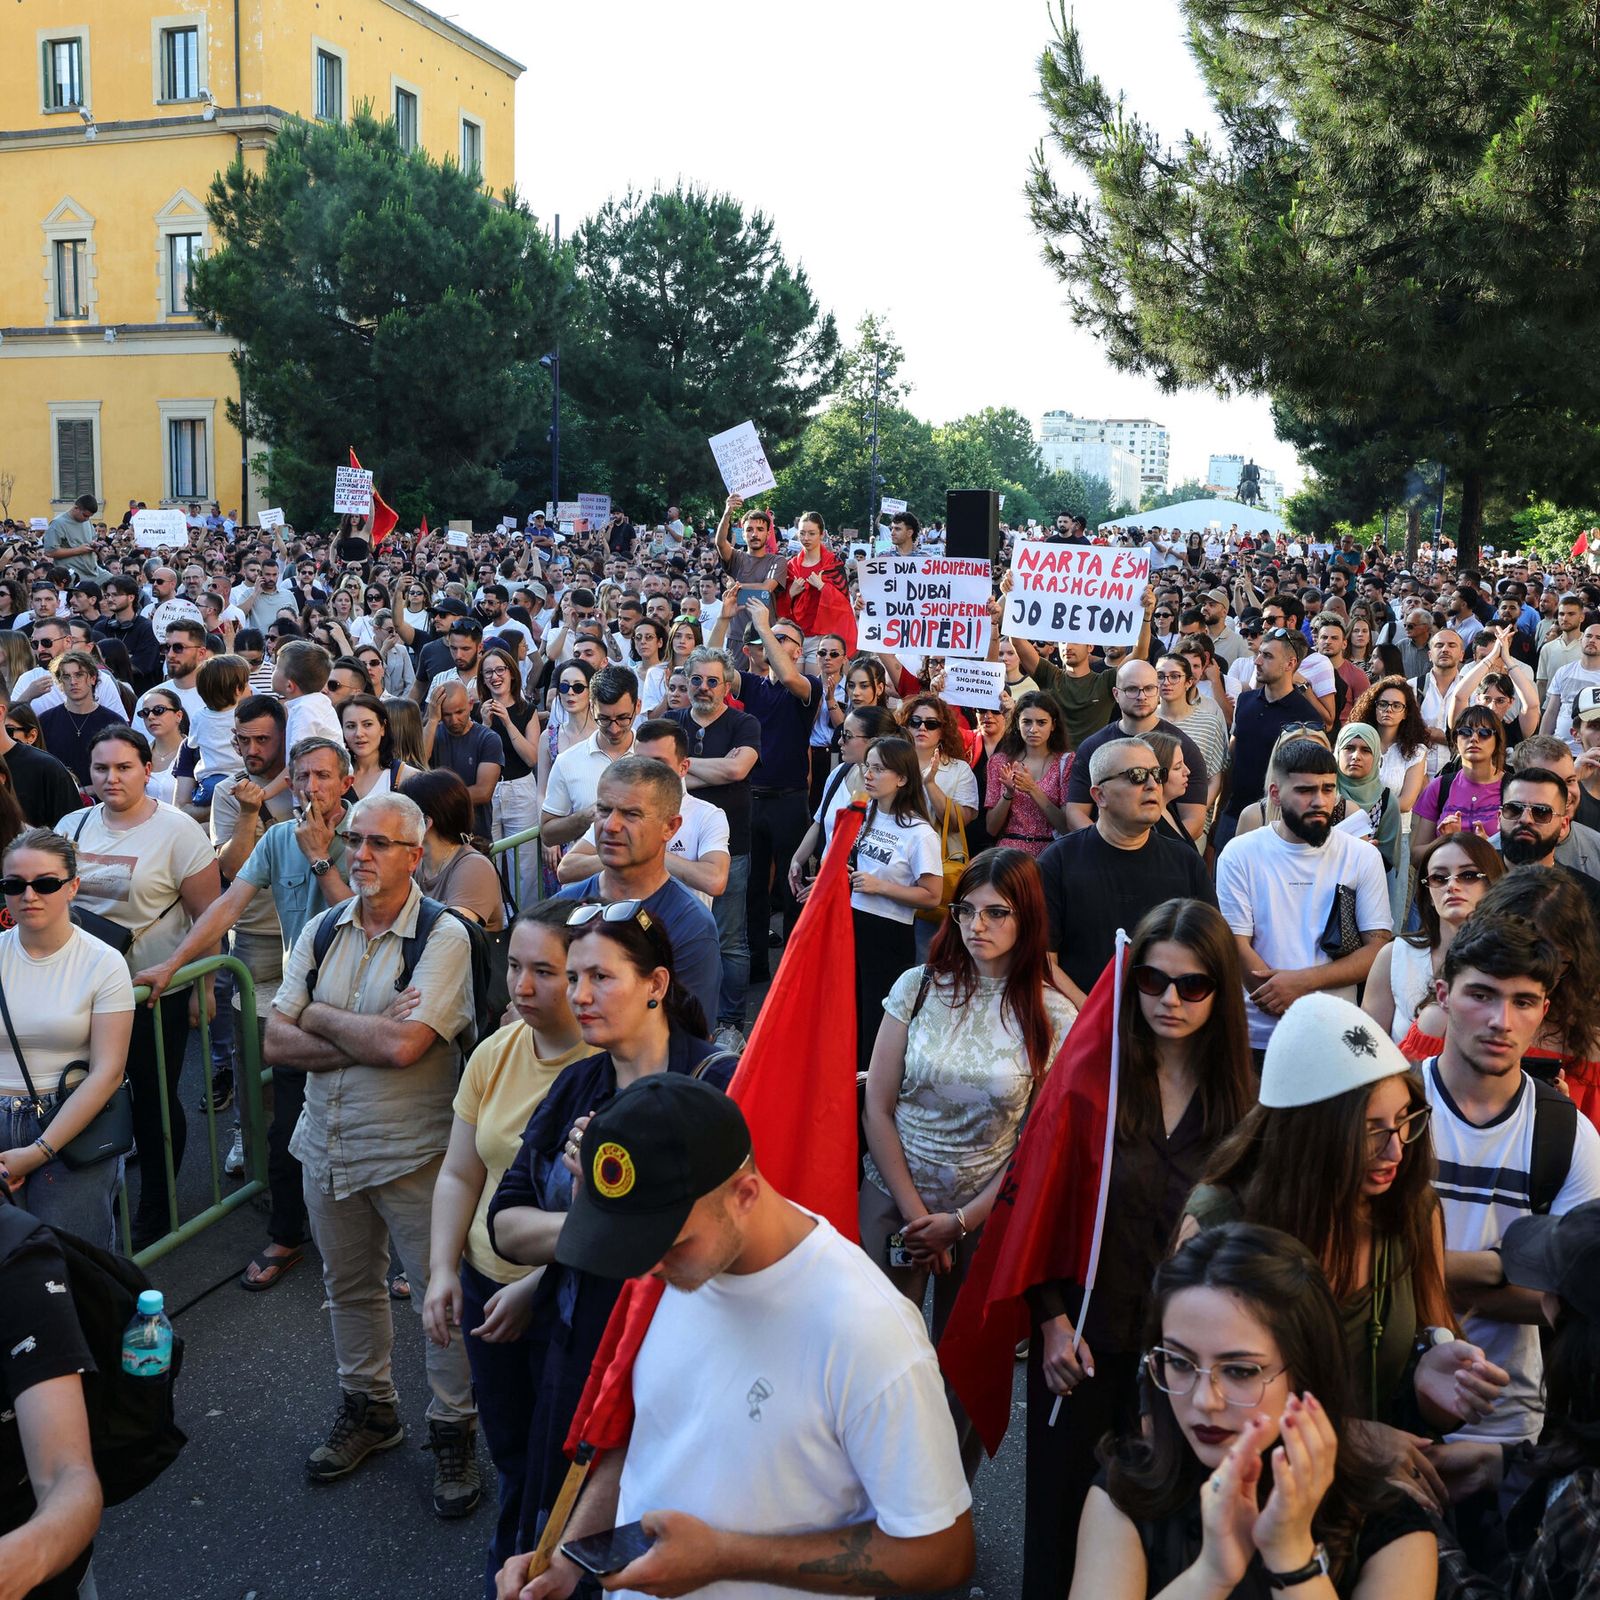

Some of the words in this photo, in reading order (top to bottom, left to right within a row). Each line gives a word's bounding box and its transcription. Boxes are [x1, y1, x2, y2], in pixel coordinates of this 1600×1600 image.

[866, 562, 888, 575] SE
[894, 562, 918, 575] DUA
[921, 559, 991, 578] SHQIPËRINË
[1017, 548, 1103, 577] NARTA
[1020, 572, 1133, 602] TRASHGIMI
[866, 601, 877, 616] E
[886, 602, 915, 616] DUA
[1012, 599, 1042, 626] JO
[1051, 602, 1134, 634] BETON
[966, 687, 993, 695] PARTIA!
